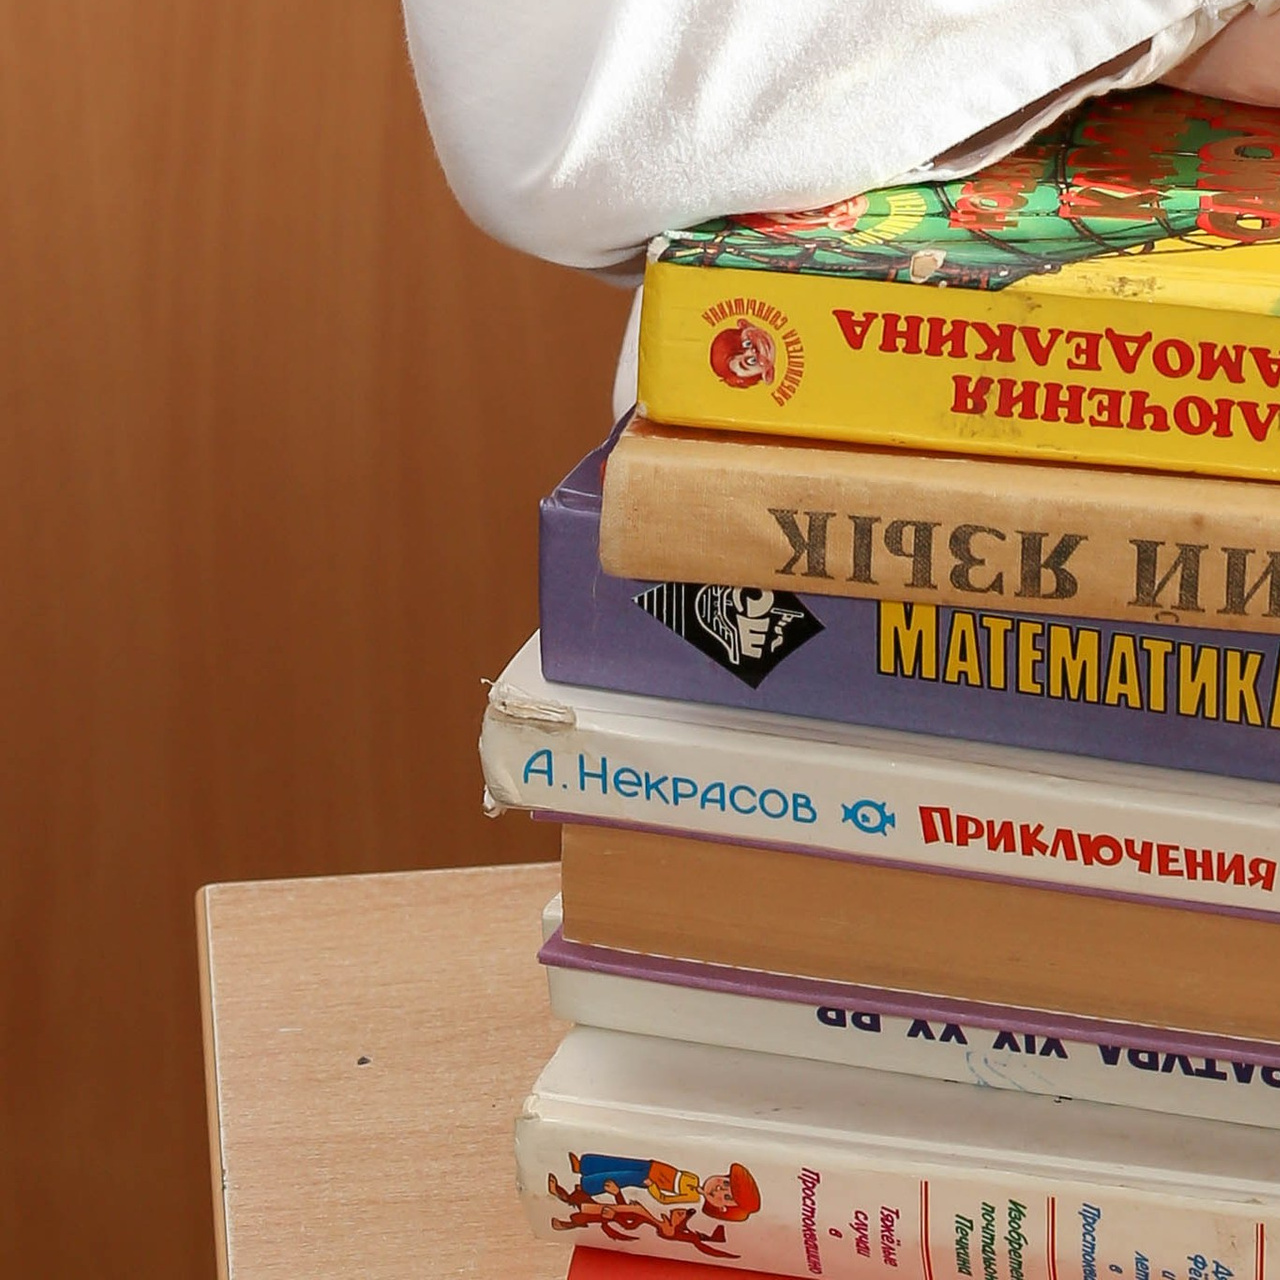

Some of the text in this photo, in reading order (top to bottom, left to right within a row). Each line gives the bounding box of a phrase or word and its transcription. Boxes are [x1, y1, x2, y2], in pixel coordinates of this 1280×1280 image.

[765, 507, 1089, 600] ЯЗЫК
[521, 748, 569, 790] А.
[848, 1209, 871, 1259] случаи
[879, 1205, 902, 1268] Тяжёлые
[954, 1213, 975, 1278] Печкина
